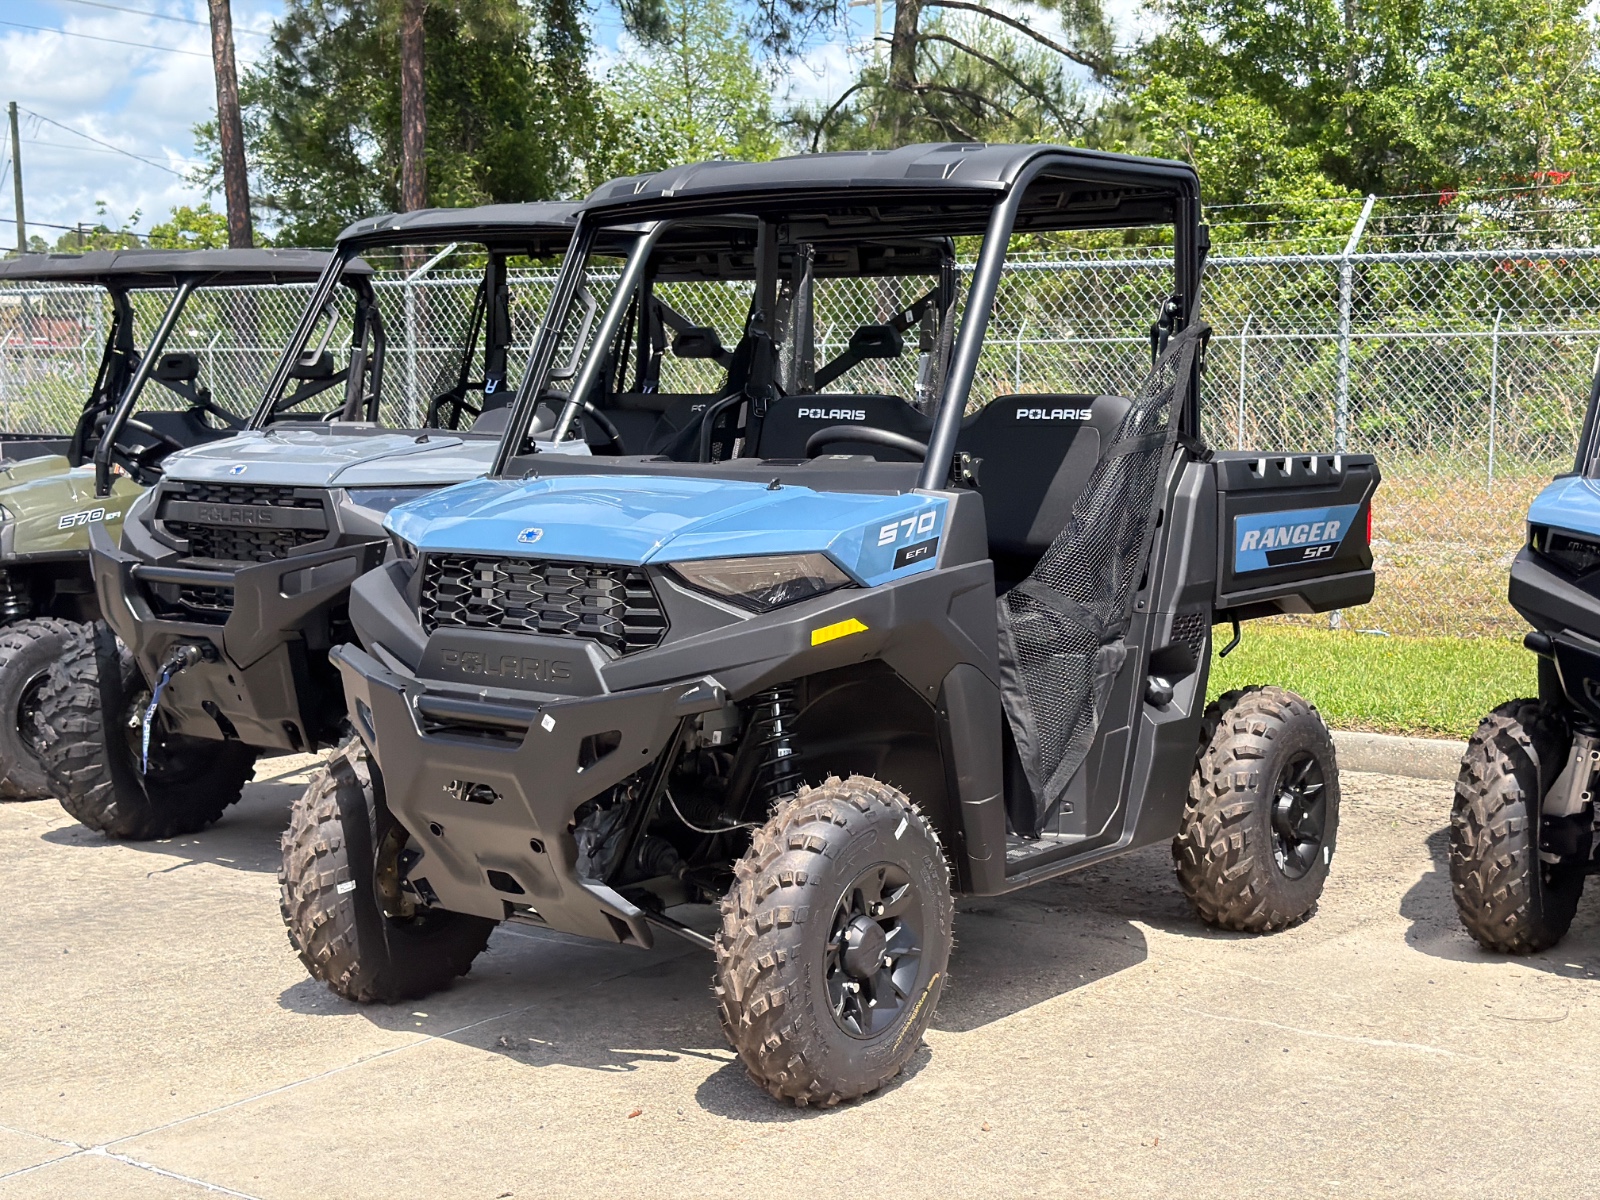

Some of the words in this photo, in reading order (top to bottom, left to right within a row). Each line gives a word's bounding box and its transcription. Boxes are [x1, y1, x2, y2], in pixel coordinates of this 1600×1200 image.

[798, 408, 866, 420] POLARIS
[1016, 408, 1093, 421] POLARIS
[58, 508, 105, 530] 570
[200, 507, 272, 523] POLARIS
[877, 510, 936, 547] 570
[1240, 520, 1340, 552] RANGER
[905, 546, 928, 560] EFI
[1302, 544, 1331, 559] SP
[440, 648, 572, 684] POLARIS
